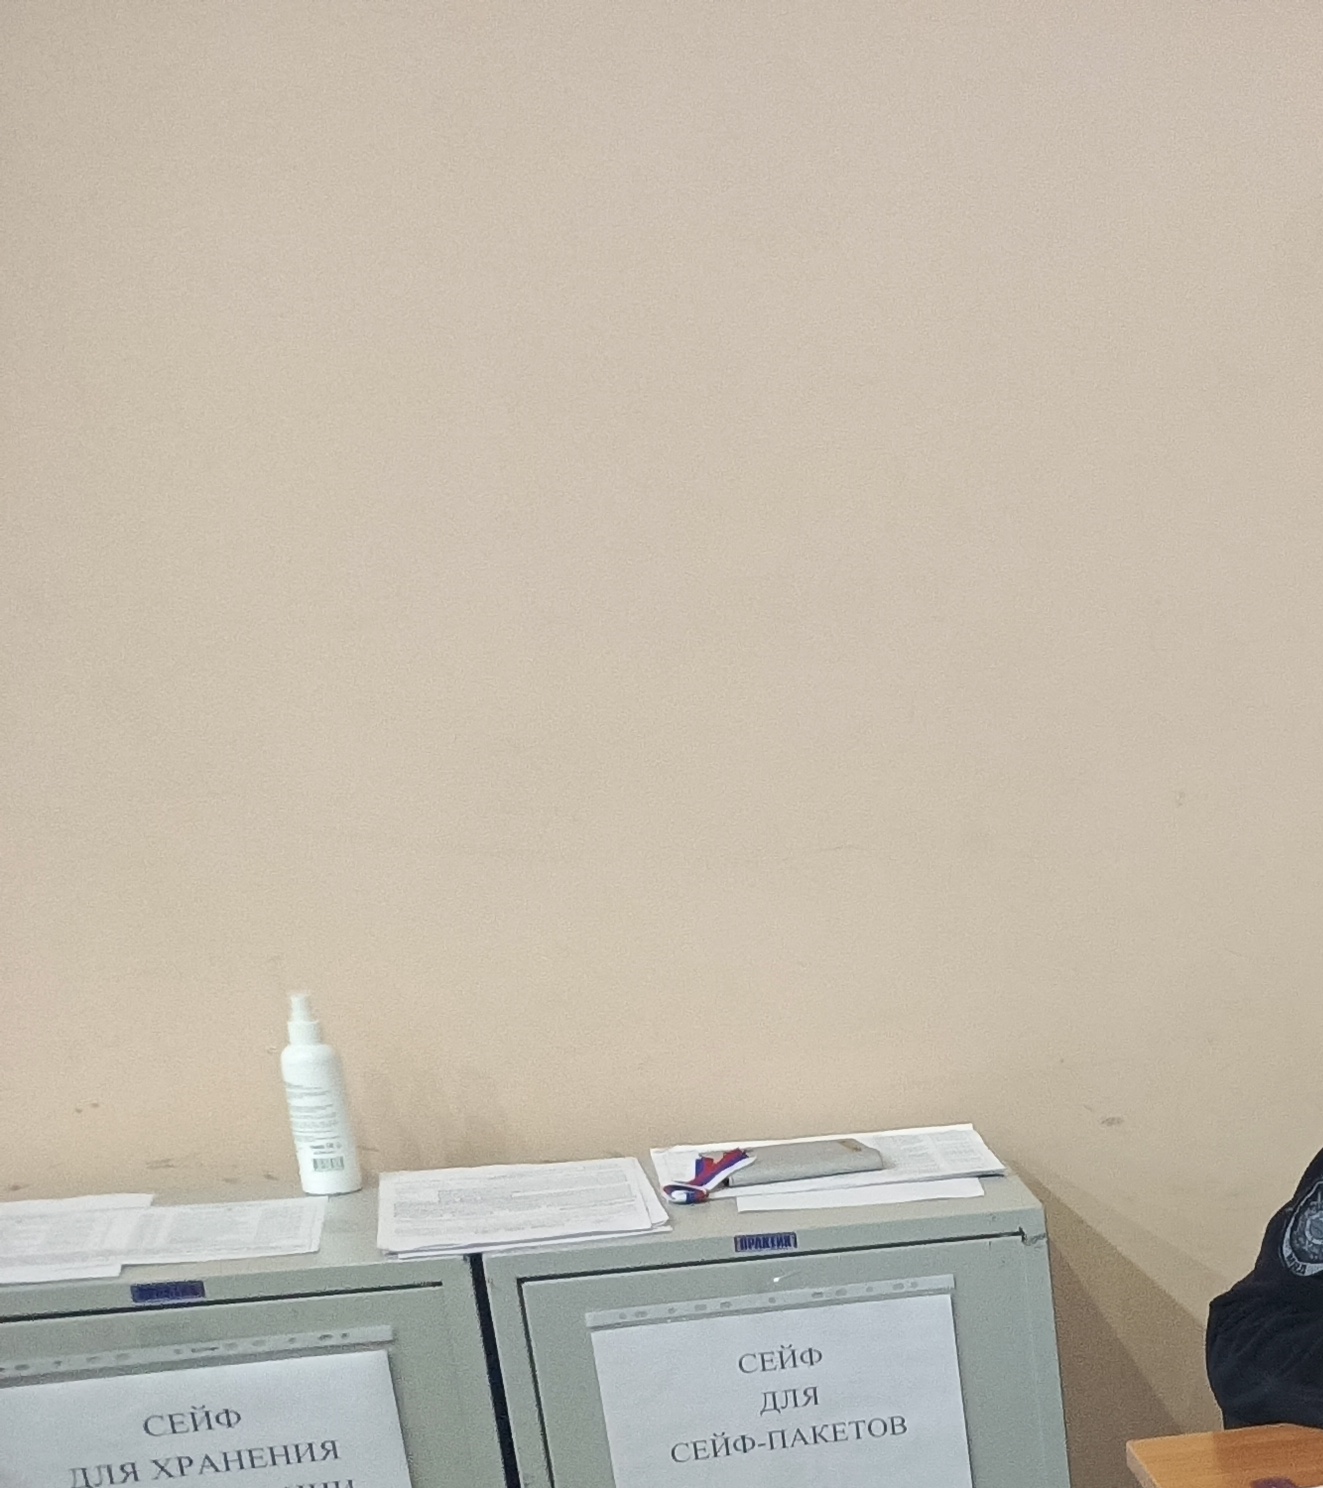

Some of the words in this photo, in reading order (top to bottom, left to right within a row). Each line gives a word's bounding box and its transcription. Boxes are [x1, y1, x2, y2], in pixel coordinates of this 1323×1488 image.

[738, 1344, 823, 1374] СЕЙФ
[759, 1386, 820, 1416] ДЛЯ
[142, 1405, 242, 1437] СЕЙФ
[670, 1415, 908, 1463] СЕЙФ-ПАКЕТОВ
[151, 1439, 341, 1481] ХРАНЕНИЯ
